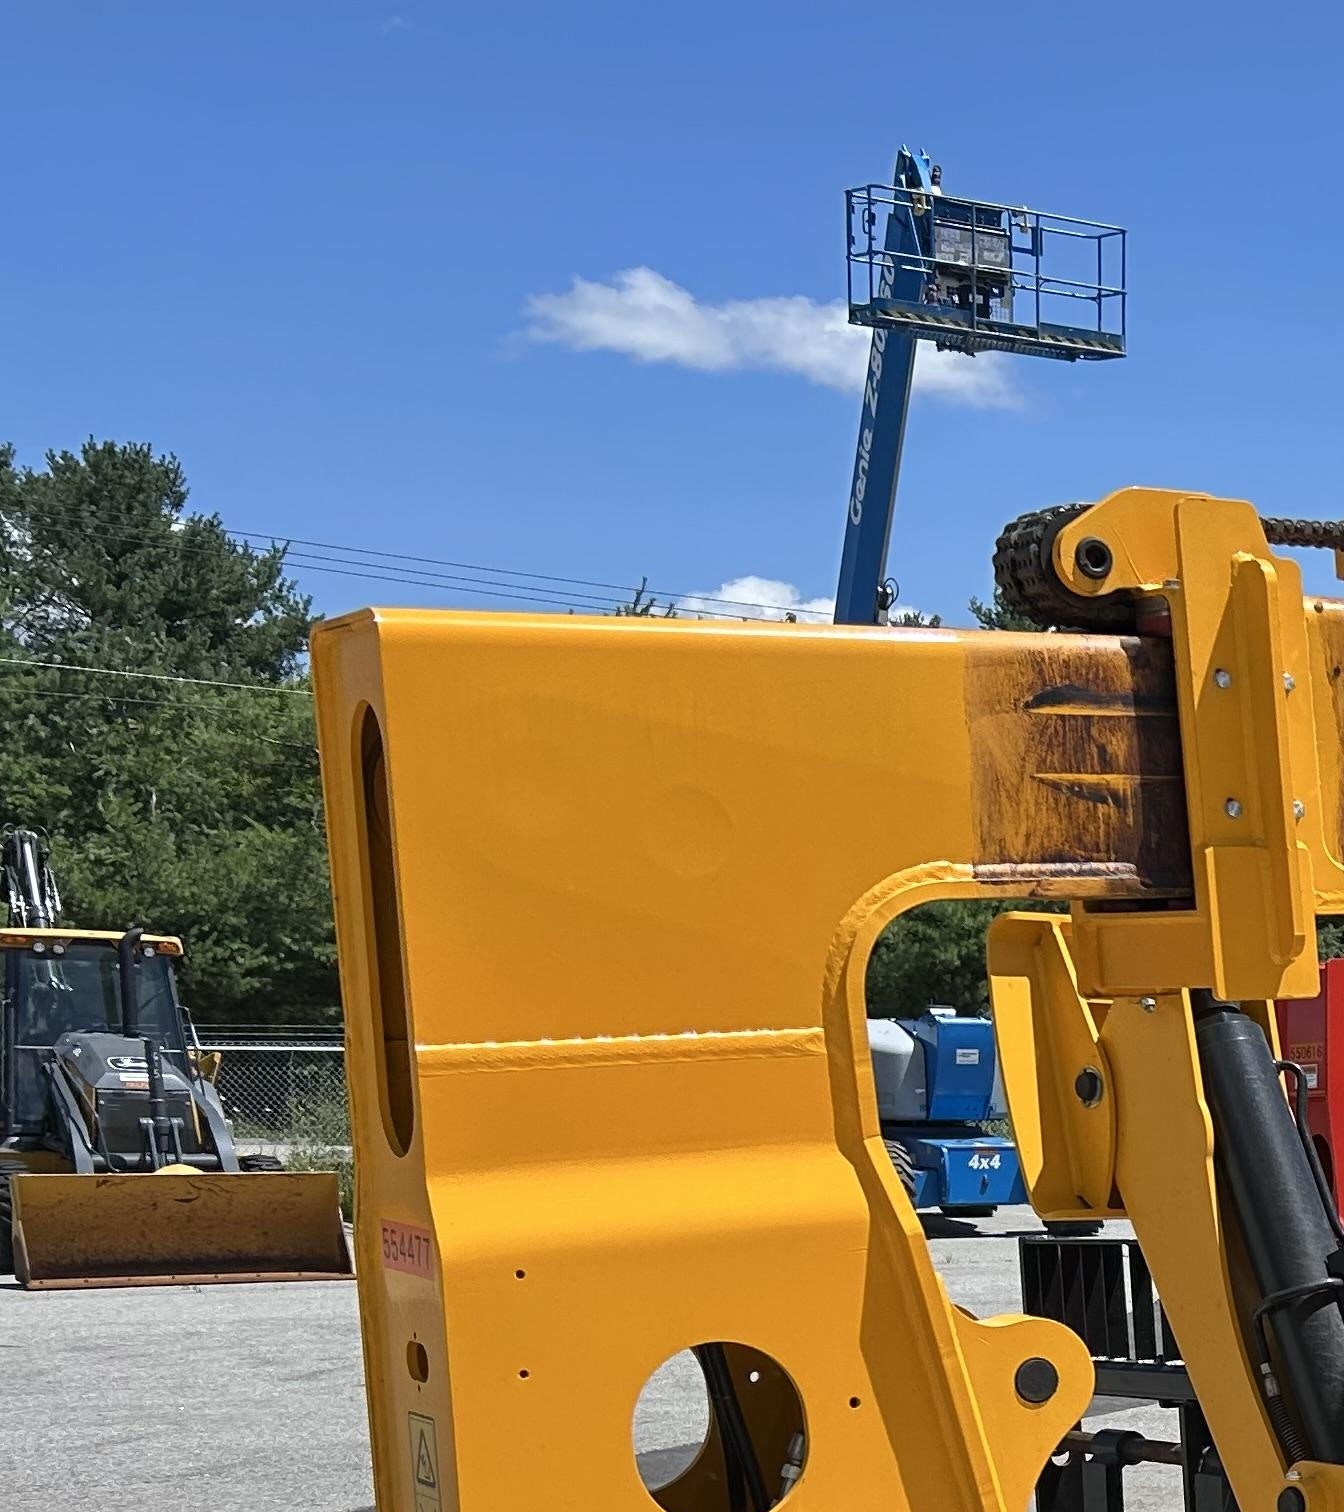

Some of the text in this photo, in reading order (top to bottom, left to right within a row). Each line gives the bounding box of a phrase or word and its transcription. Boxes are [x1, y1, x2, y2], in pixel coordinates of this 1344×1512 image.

[851, 429, 873, 527] Genie
[968, 1154, 1001, 1170] 4x4
[382, 1227, 430, 1271] 554477
